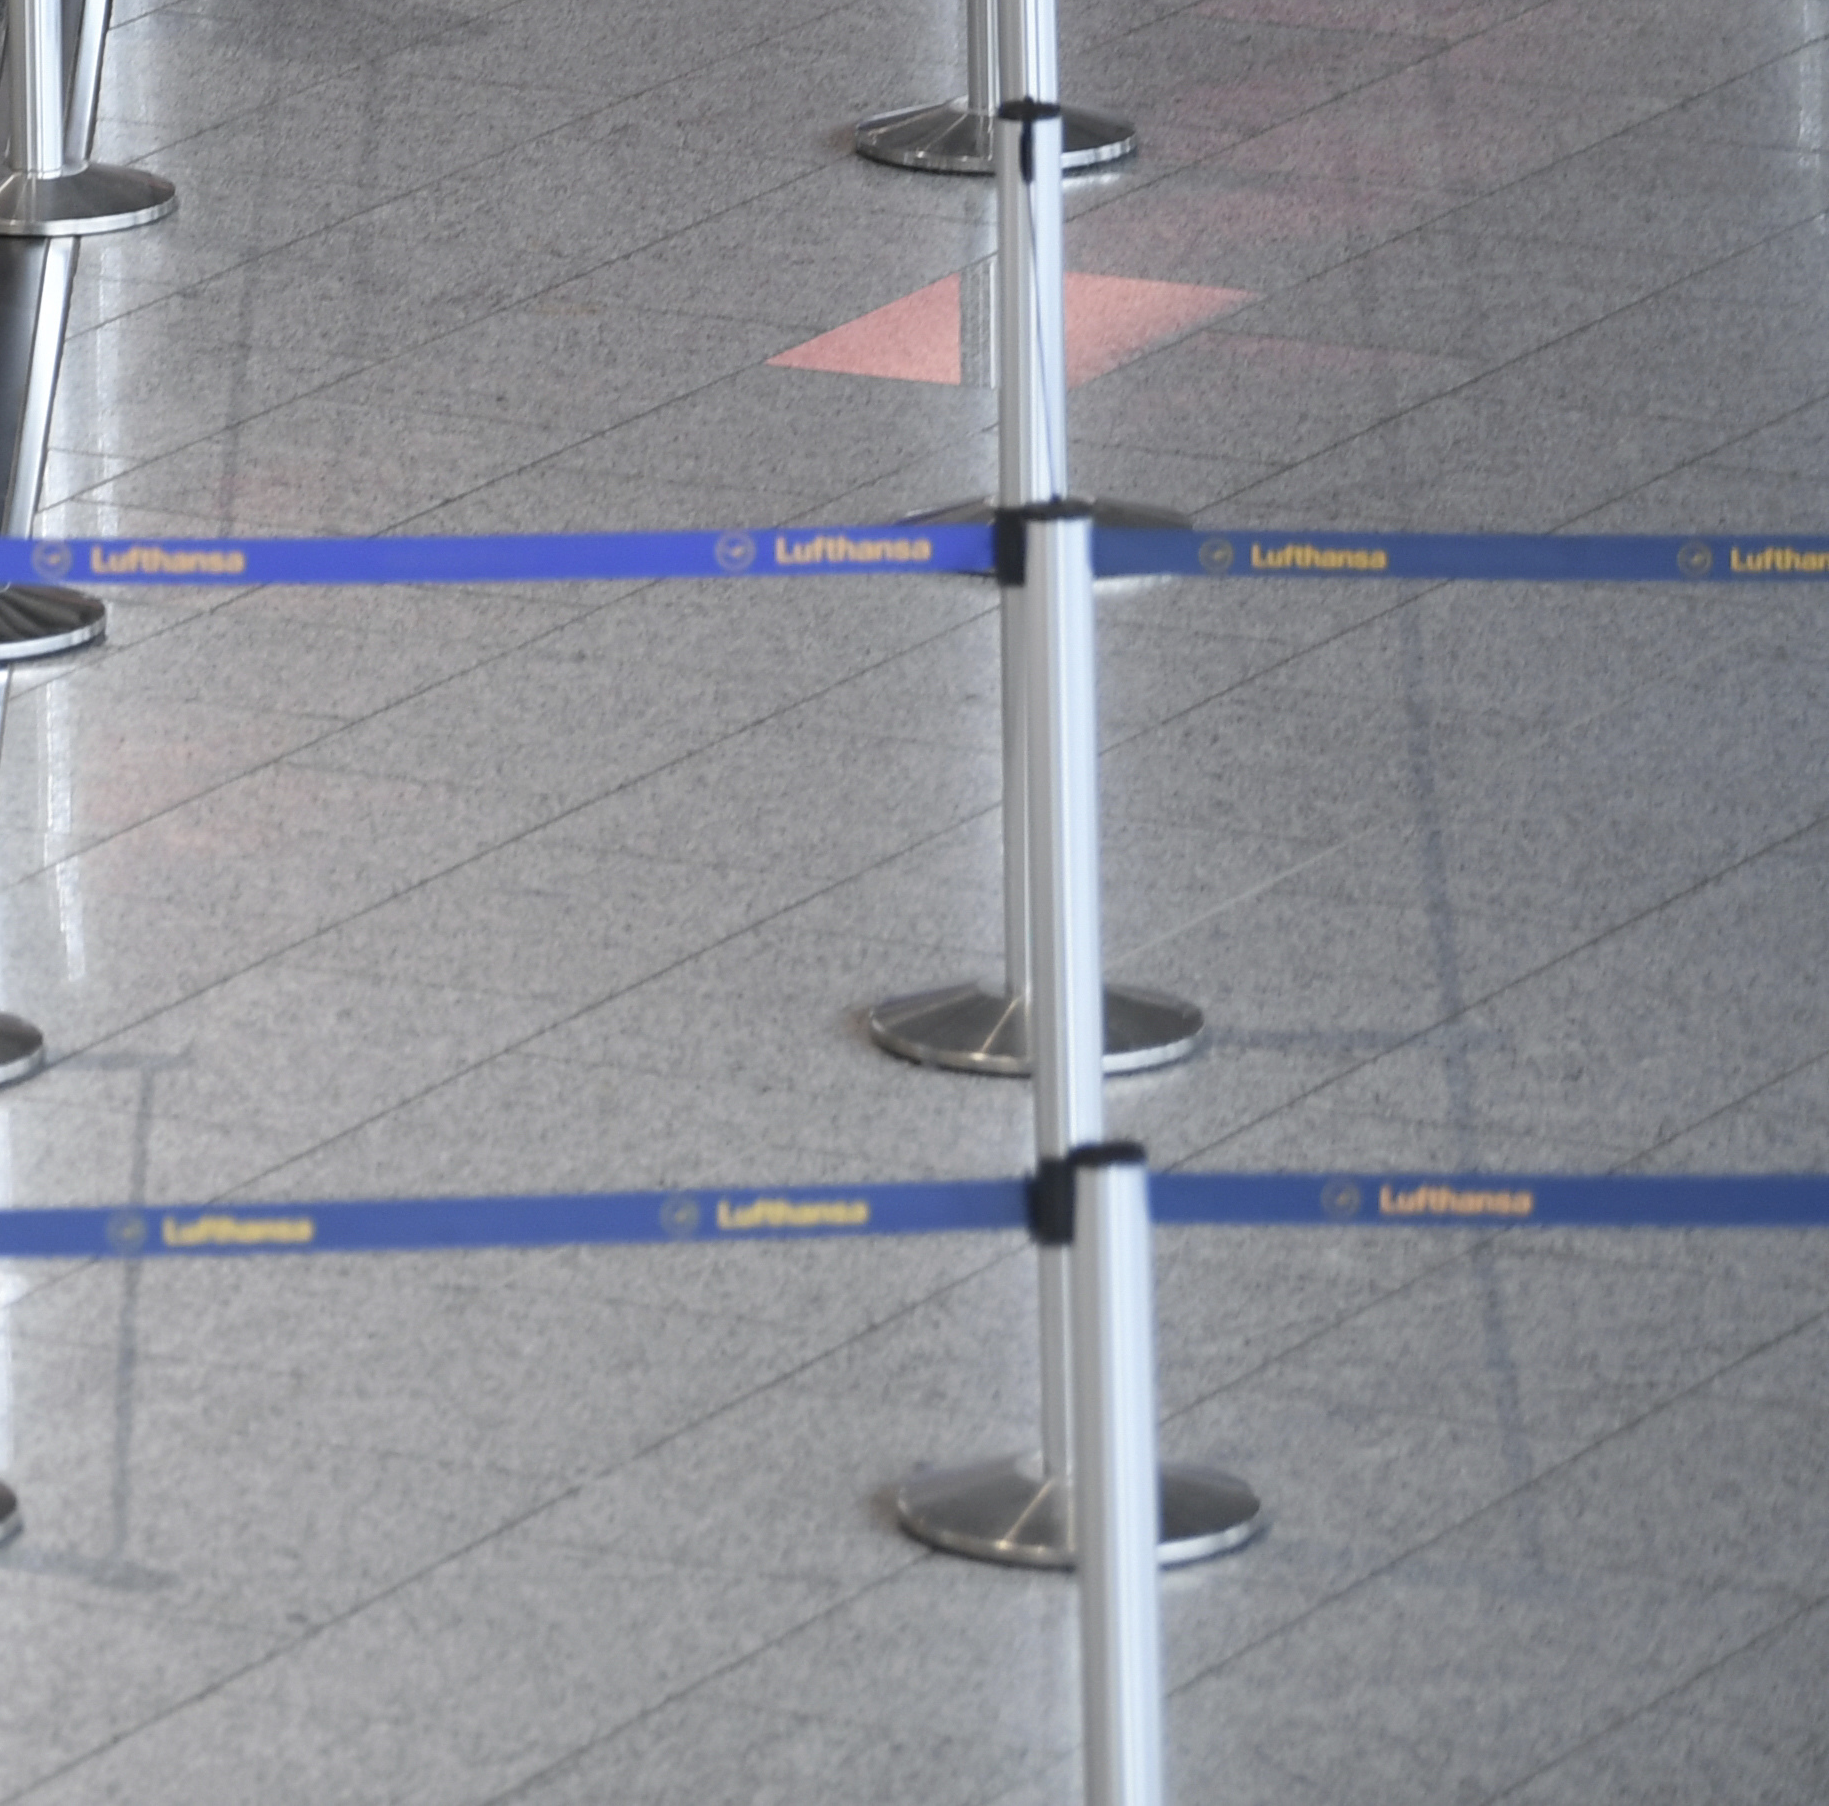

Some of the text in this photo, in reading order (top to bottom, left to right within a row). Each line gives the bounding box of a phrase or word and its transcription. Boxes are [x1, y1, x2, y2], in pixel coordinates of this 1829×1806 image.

[90, 543, 246, 576] Lufthansa
[775, 535, 932, 565] Lufthansa
[1250, 543, 1389, 571] Lufthansa
[1730, 546, 1829, 572] Lufthan
[1378, 1183, 1535, 1218] Lufthansa
